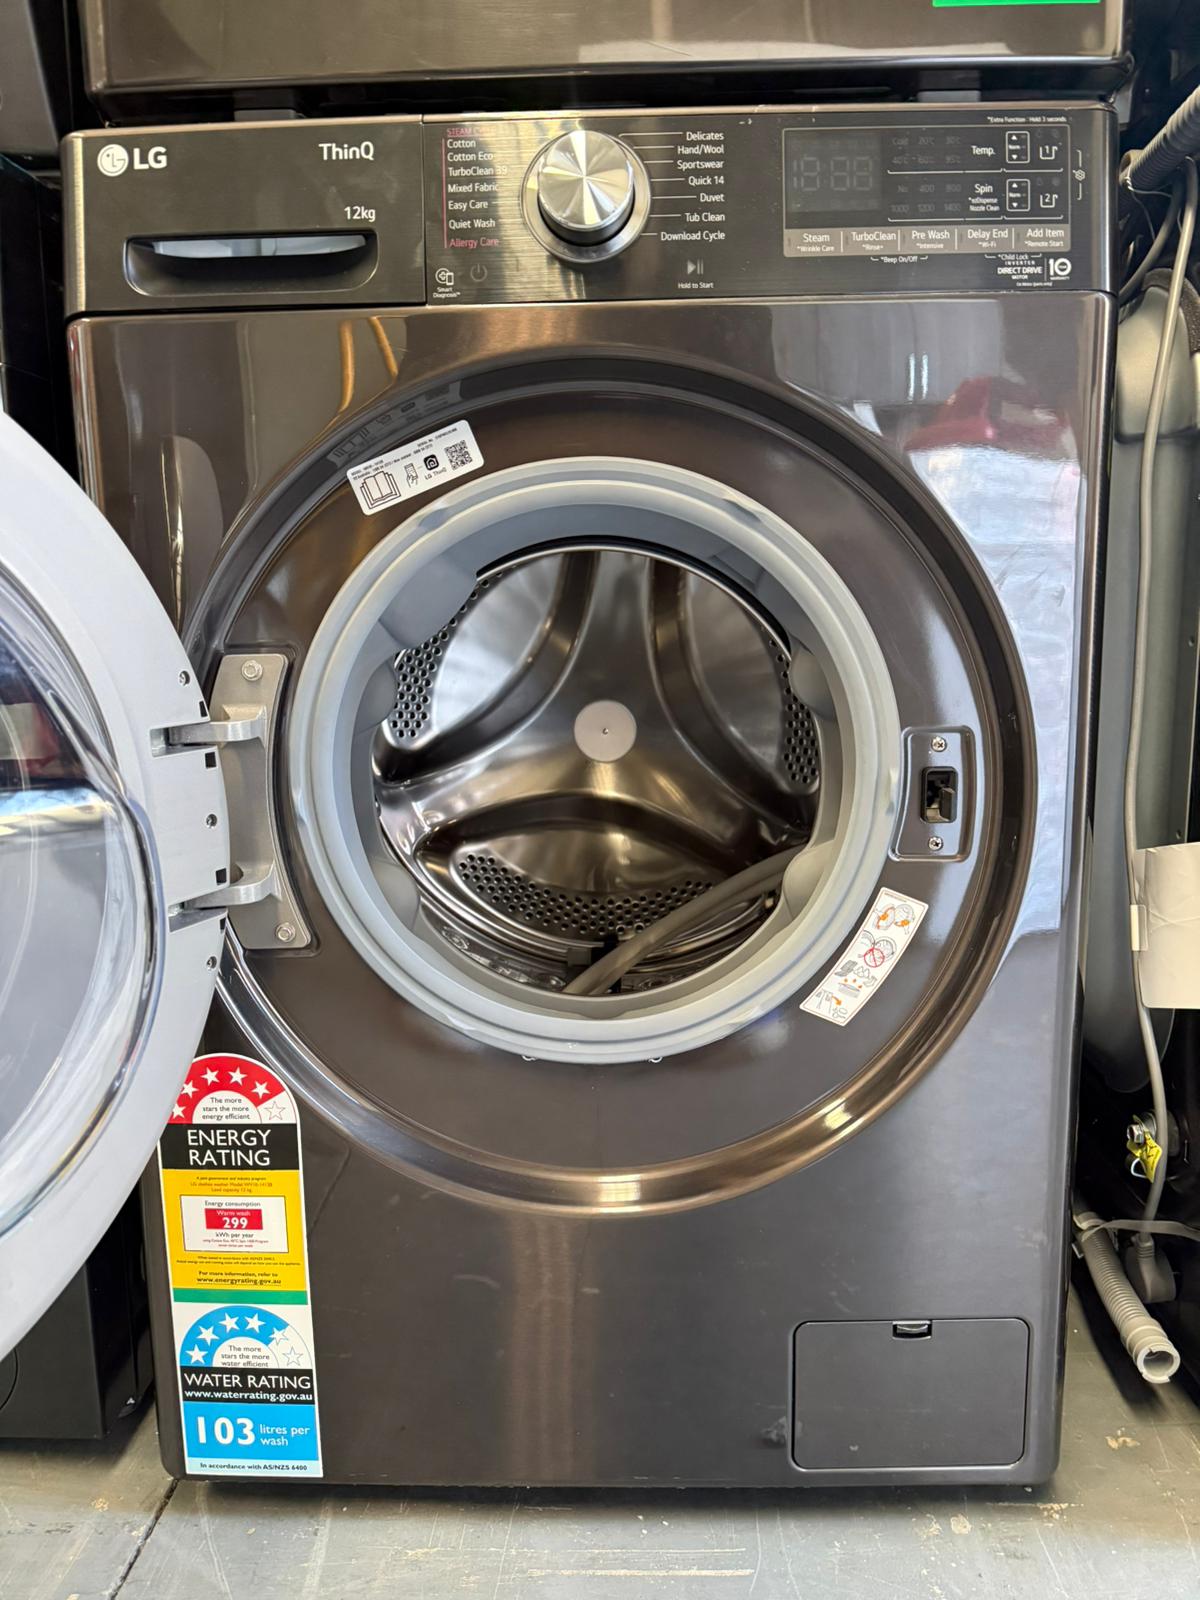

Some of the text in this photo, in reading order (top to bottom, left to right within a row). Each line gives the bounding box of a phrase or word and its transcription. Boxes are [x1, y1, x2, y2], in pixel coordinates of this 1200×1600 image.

[686, 131, 724, 141] Delicates
[447, 139, 476, 149] Cotton
[677, 144, 724, 155] Hand/Wool
[319, 141, 375, 161] ThinQ
[971, 145, 996, 157] Temp.
[133, 146, 167, 169] LG
[447, 152, 494, 162] Cotton Eco
[448, 166, 494, 176] TurboClean
[677, 160, 724, 171] Sportswear
[688, 176, 724, 187] Quick 14
[447, 182, 500, 193] Mixed Fabric
[974, 183, 994, 195] Spin
[700, 192, 724, 203] Duvet
[448, 200, 489, 212] Easy Care
[344, 206, 376, 222] 12kg
[684, 212, 726, 222] Tub Clean
[448, 218, 496, 230] Quiet Wash
[660, 230, 726, 242] Download Cycle
[802, 232, 830, 243] Steam
[851, 232, 897, 241] TurboClean
[912, 229, 951, 240] Pre Wash
[967, 228, 1008, 240] Delay End
[1026, 228, 1064, 238] Add Item
[449, 237, 500, 249] Allergy Care
[898, 256, 918, 264] On/Off
[997, 266, 1042, 275] DIRECT DRIVE
[1048, 258, 1072, 276] 10
[187, 1129, 272, 1146] ENERGY
[188, 1149, 270, 1166] RATING
[204, 1200, 224, 1208] Energy
[222, 1216, 248, 1229] 299
[231, 1232, 241, 1240] per
[242, 1232, 254, 1240] year
[196, 1278, 282, 1286] www.energyrating.gov.au
[242, 1360, 269, 1368] efficient
[184, 1373, 311, 1390] WATER RATING
[184, 1390, 312, 1402] www.waterrating.gov.au
[196, 1416, 256, 1446] 103
[259, 1424, 311, 1437] litres per
[260, 1437, 288, 1446] wash
